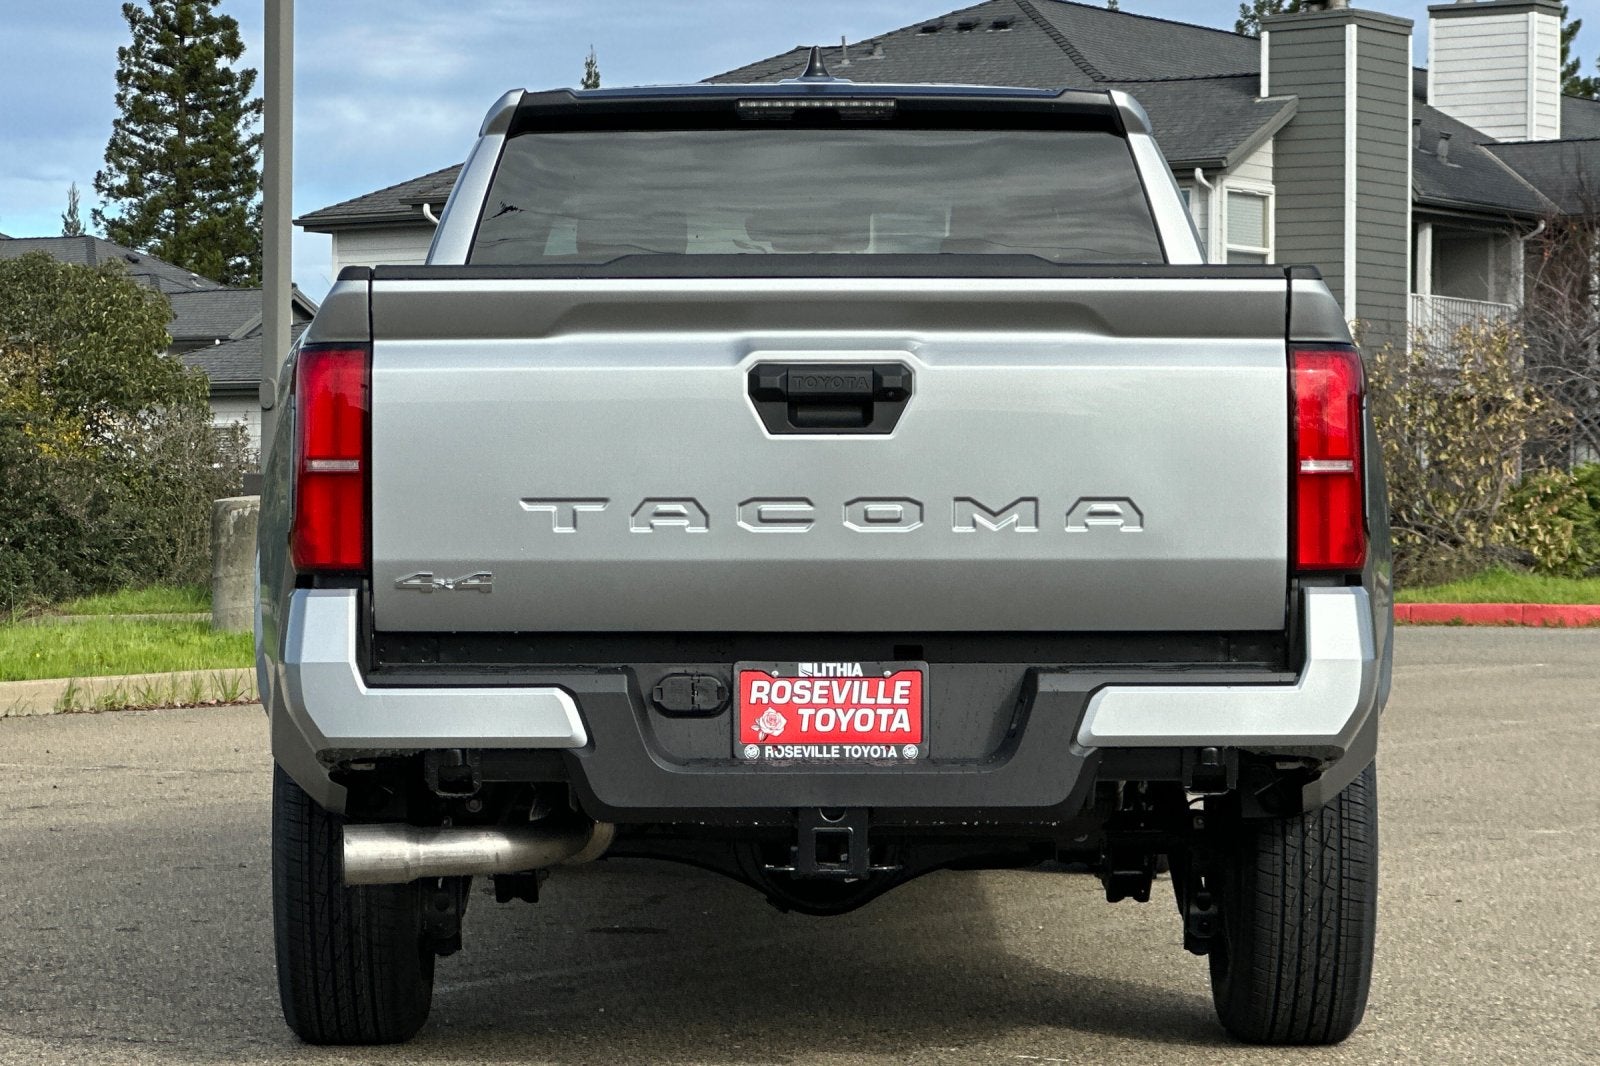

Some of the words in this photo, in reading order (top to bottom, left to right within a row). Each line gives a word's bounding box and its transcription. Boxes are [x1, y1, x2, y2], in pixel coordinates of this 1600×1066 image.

[792, 376, 869, 389] TOYOTA
[519, 497, 1144, 533] TACOMA
[812, 662, 863, 677] LITHIA
[750, 680, 911, 705] ROSEVILLE
[798, 708, 911, 732] TOYOTA
[765, 746, 840, 758] ROSEVILLE
[843, 746, 897, 758] TOYOTA
